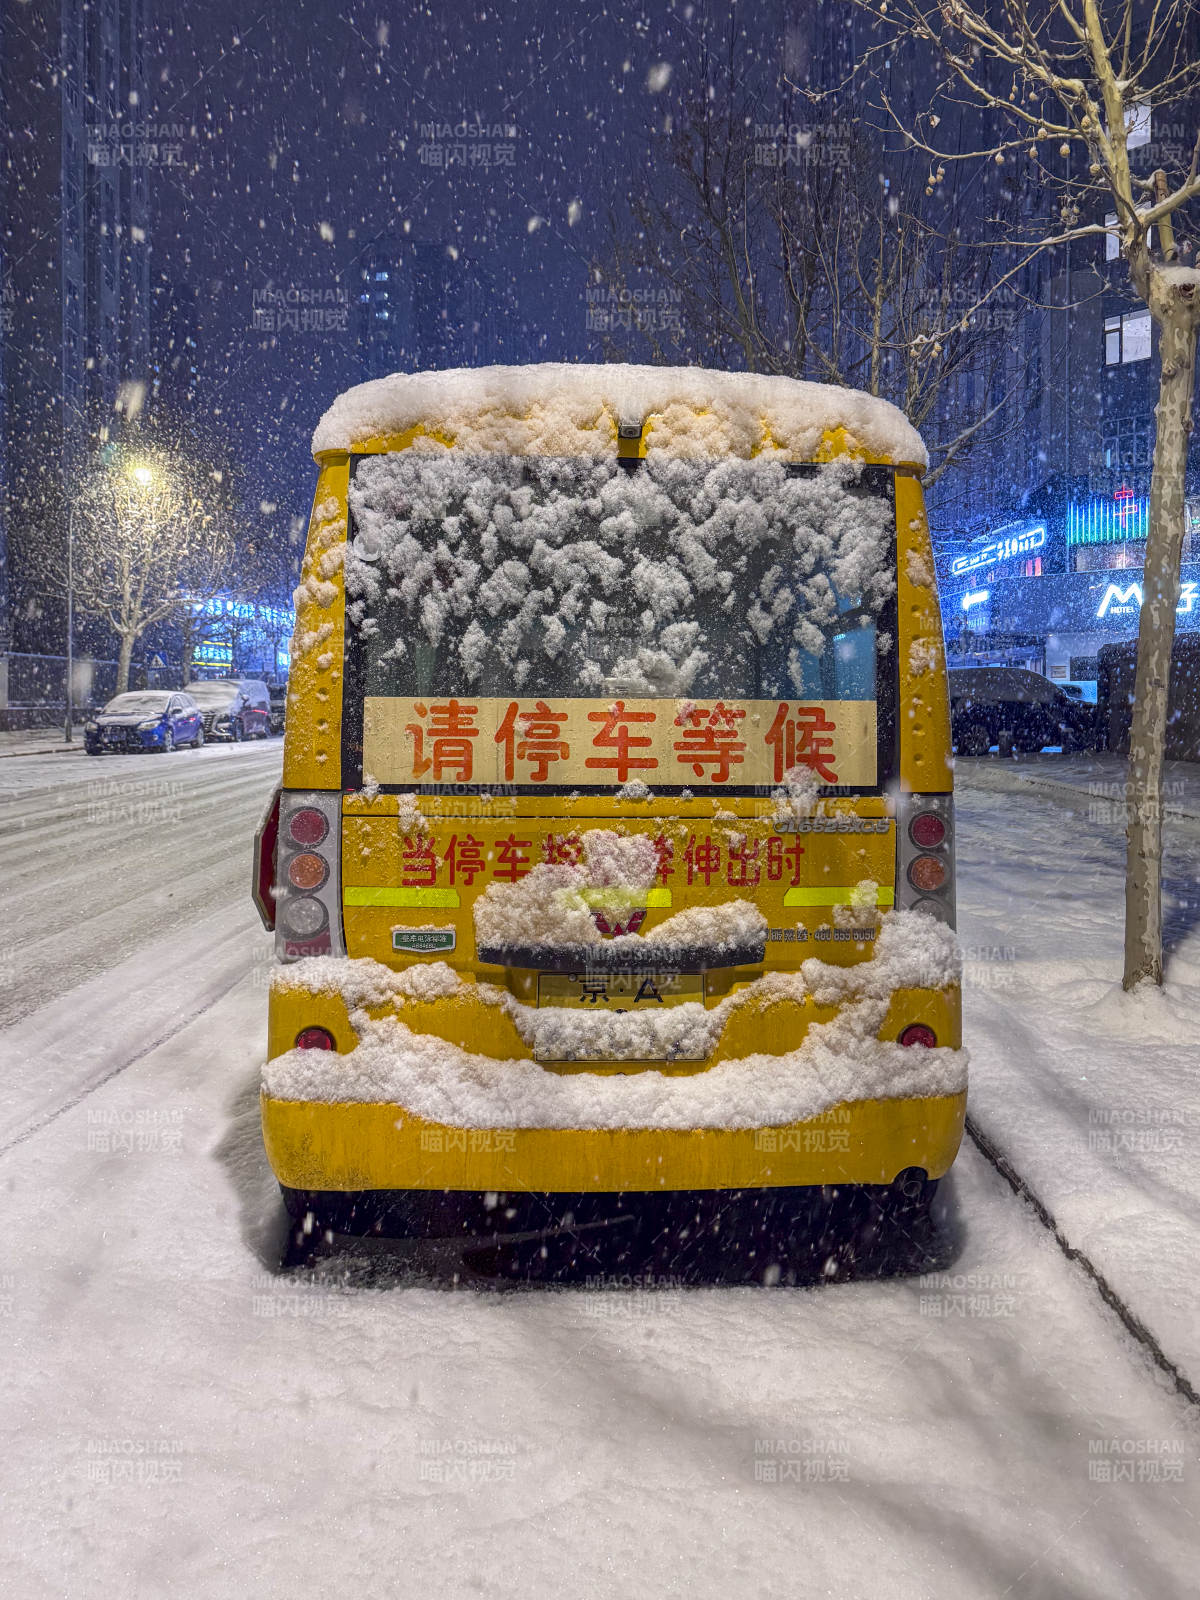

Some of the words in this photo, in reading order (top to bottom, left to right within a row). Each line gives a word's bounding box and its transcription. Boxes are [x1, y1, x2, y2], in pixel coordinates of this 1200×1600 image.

[1110, 606, 1135, 614] HOTEL
[406, 701, 838, 783] 请停车等候
